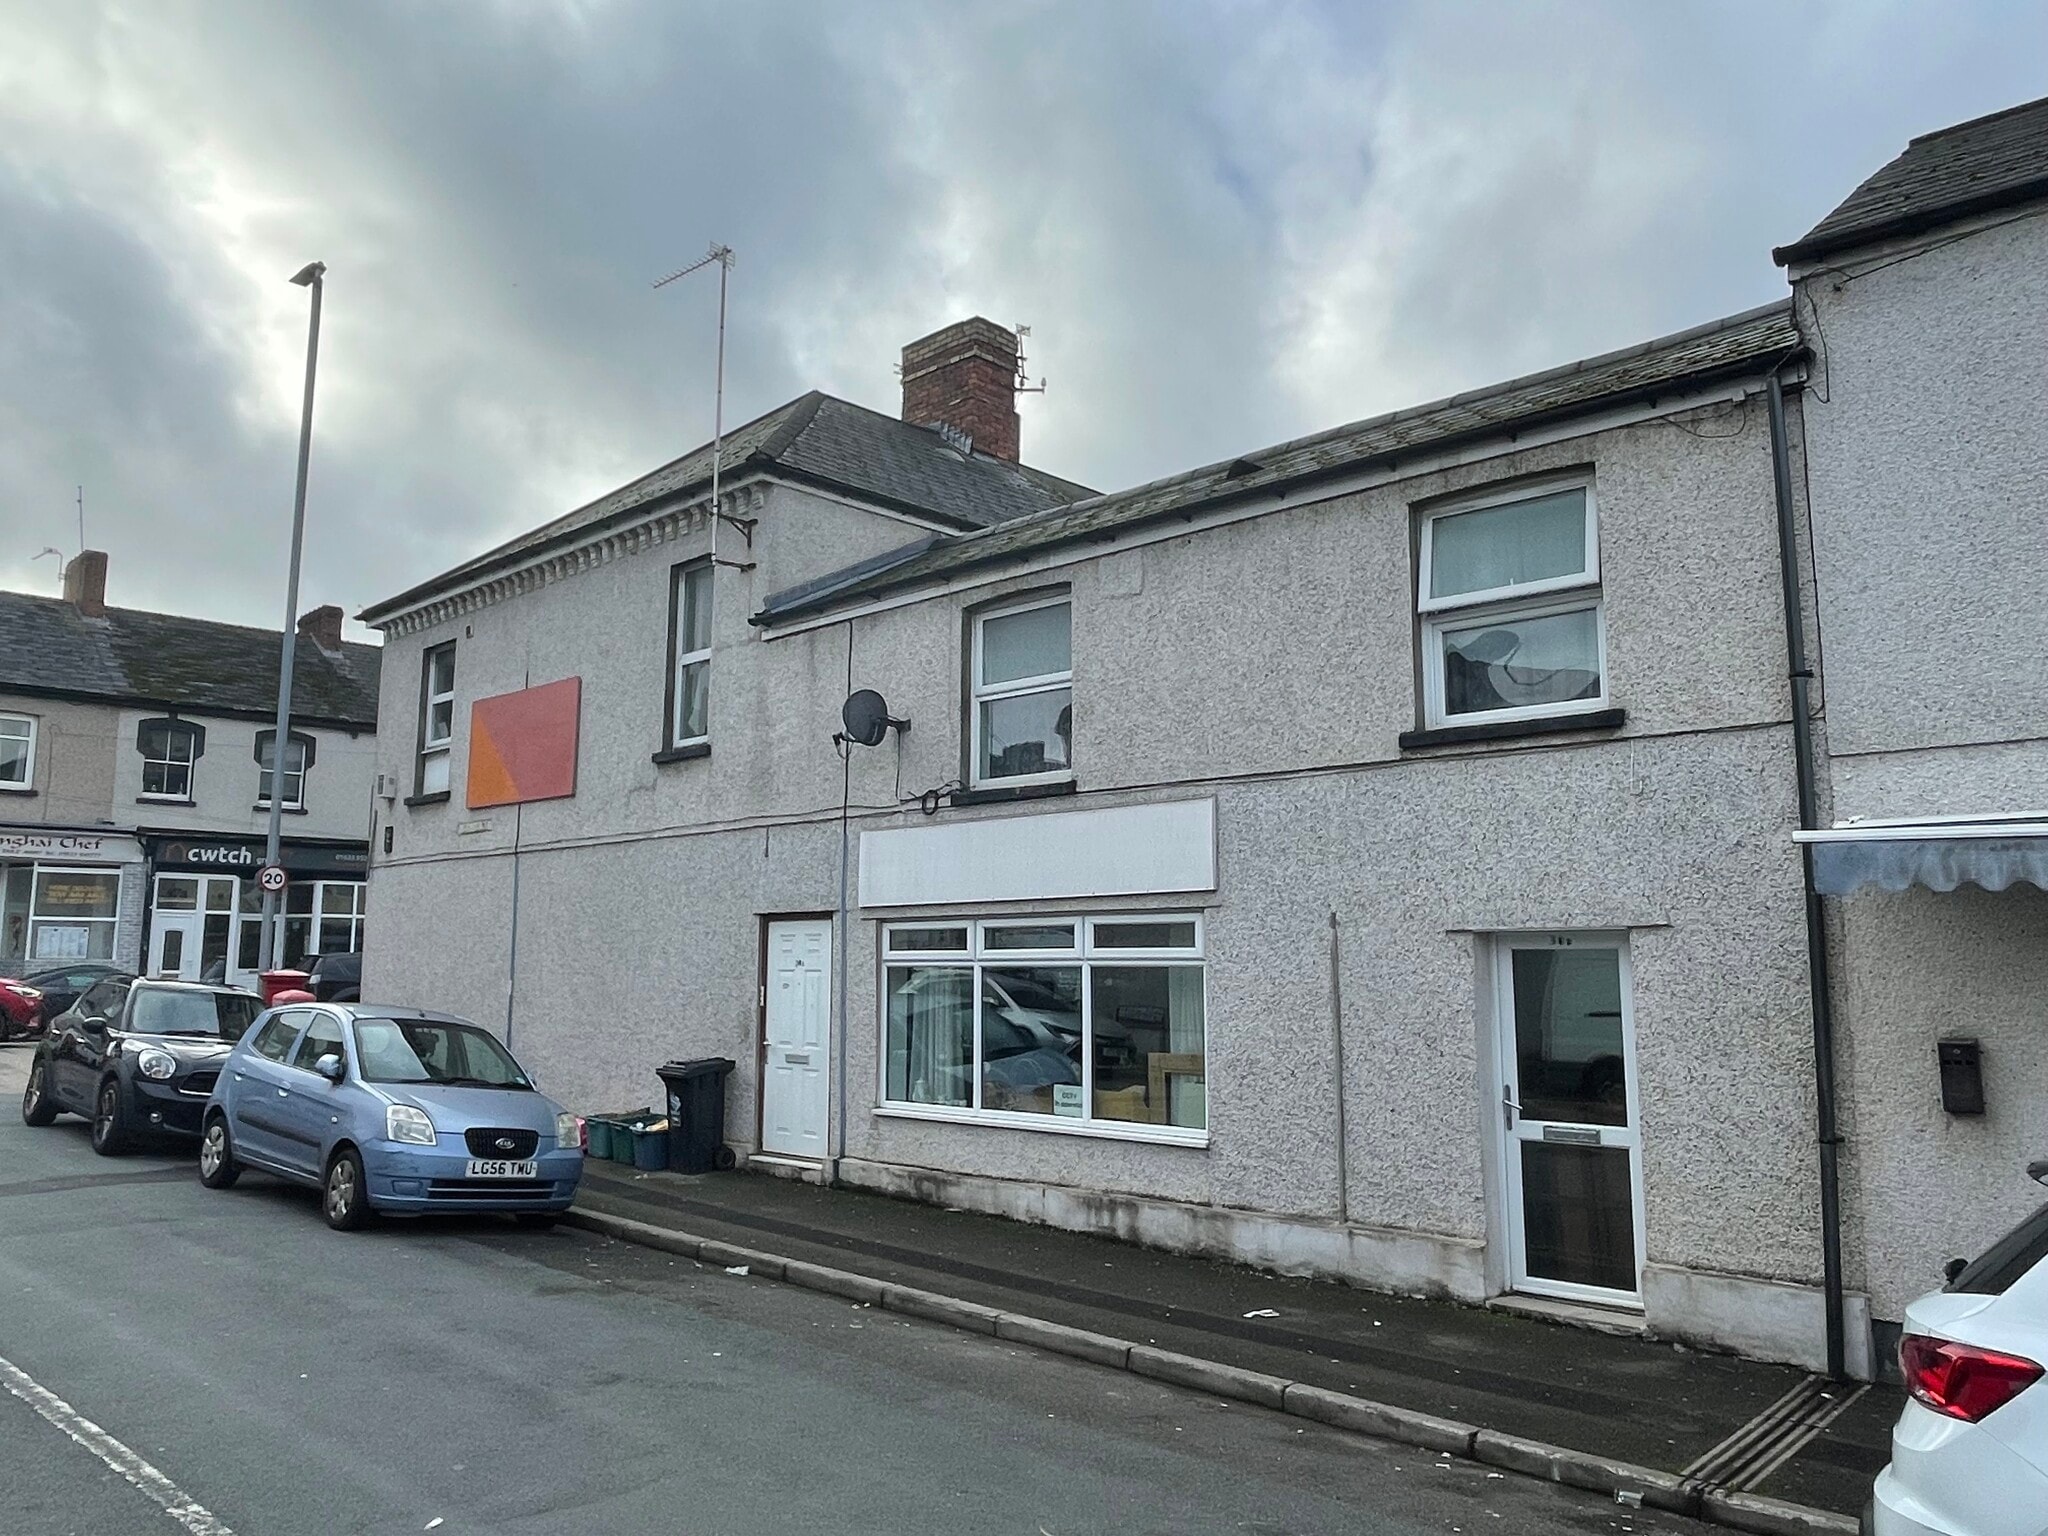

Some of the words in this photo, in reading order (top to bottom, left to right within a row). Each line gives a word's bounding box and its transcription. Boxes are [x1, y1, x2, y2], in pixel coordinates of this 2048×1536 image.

[60, 837, 104, 850] Chef
[187, 846, 252, 865] cwtch
[264, 873, 283, 885] 20
[472, 1161, 506, 1175] LG56
[510, 1161, 533, 1176] TWU
